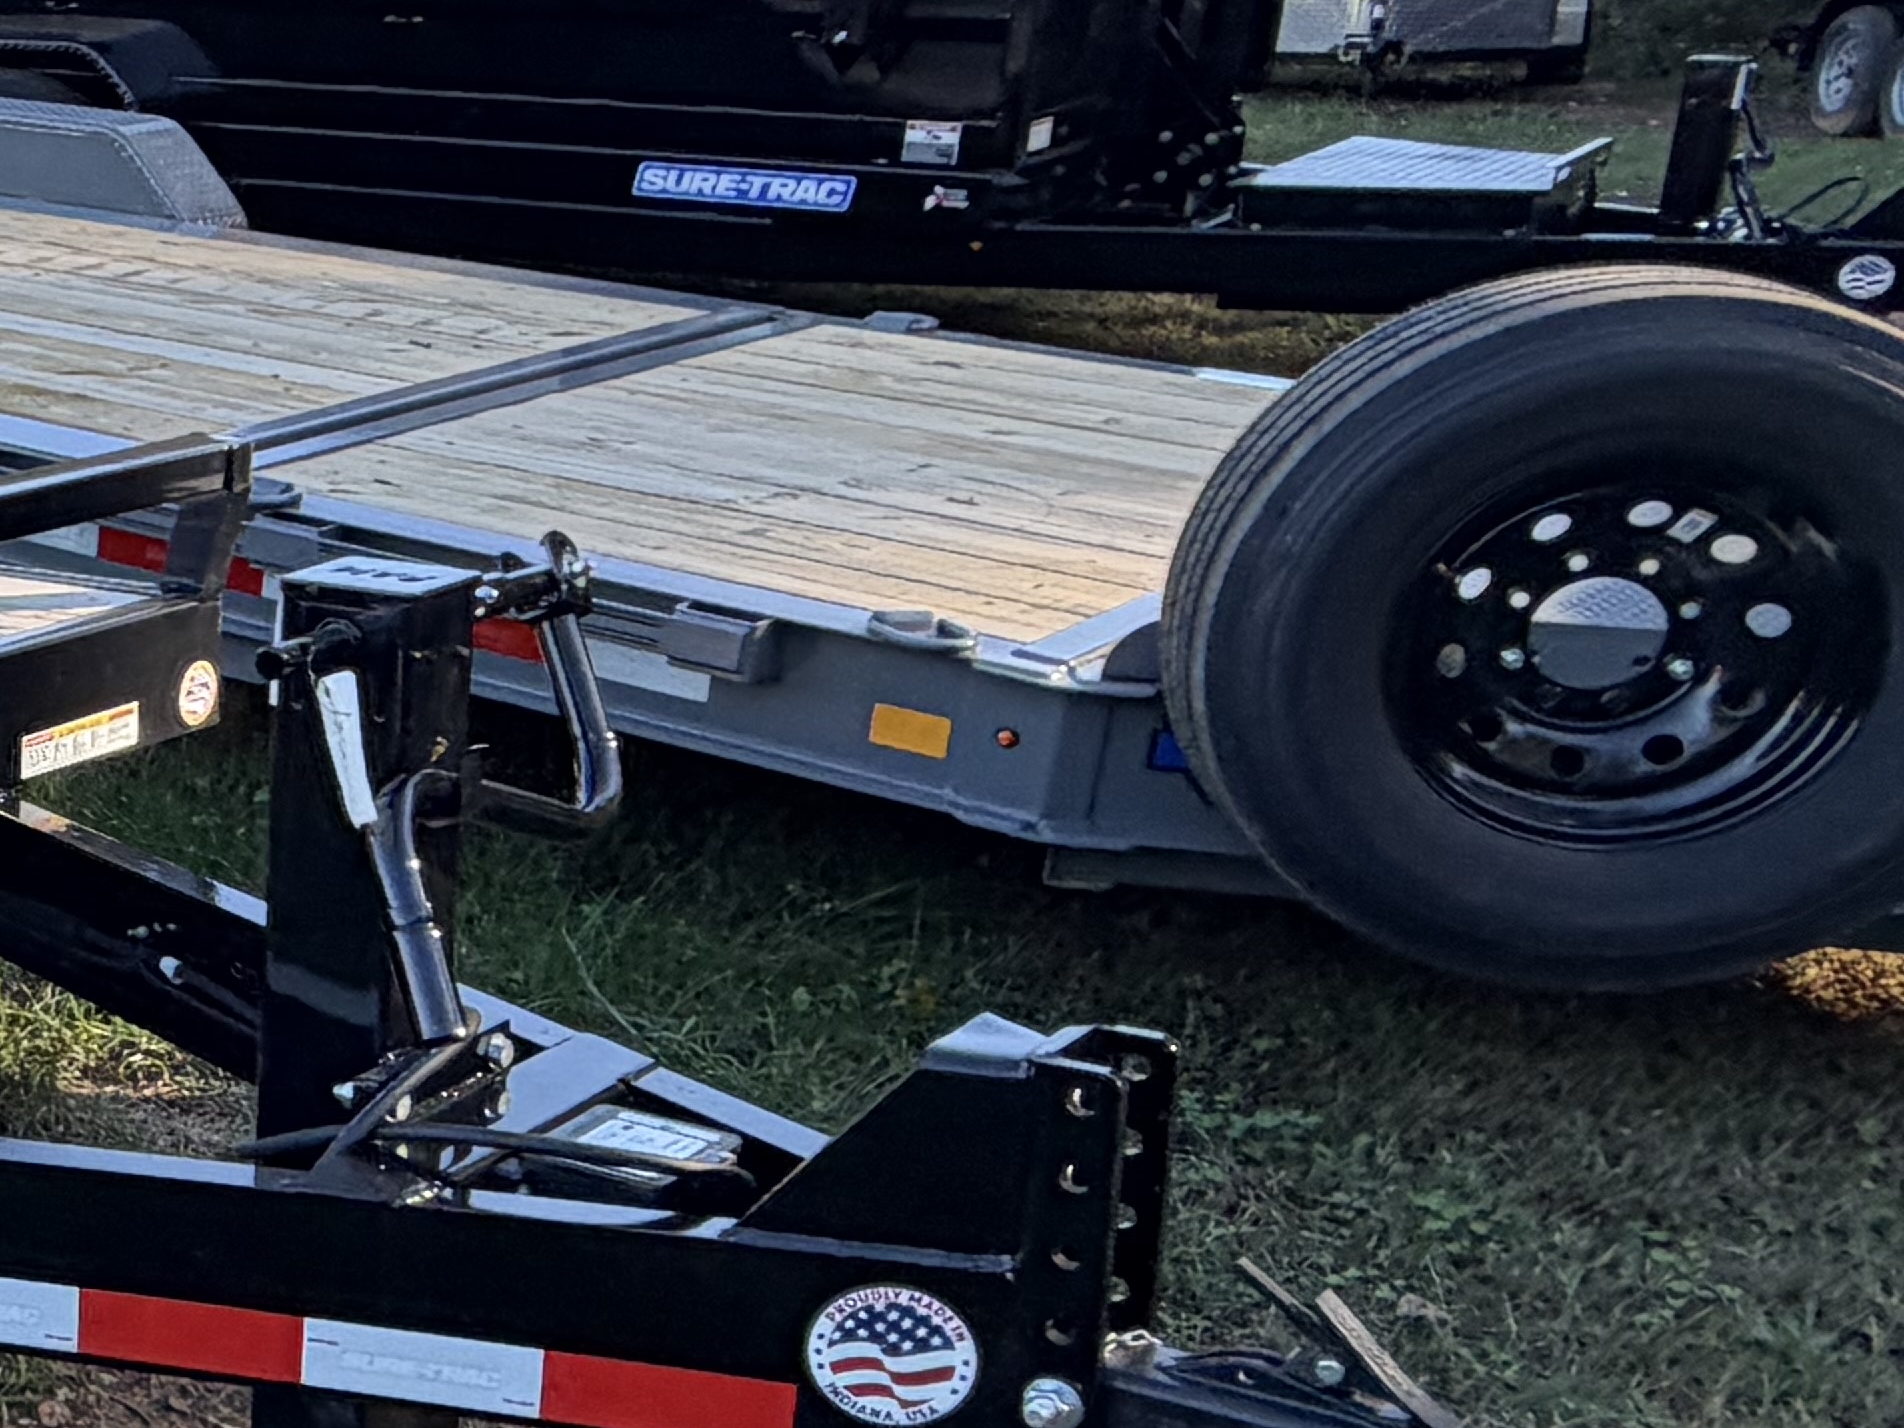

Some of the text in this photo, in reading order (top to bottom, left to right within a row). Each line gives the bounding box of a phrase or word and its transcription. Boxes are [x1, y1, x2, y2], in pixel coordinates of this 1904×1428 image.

[641, 168, 848, 205] SURE-TRAC
[825, 1290, 967, 1343] PROUDLY MADE IN
